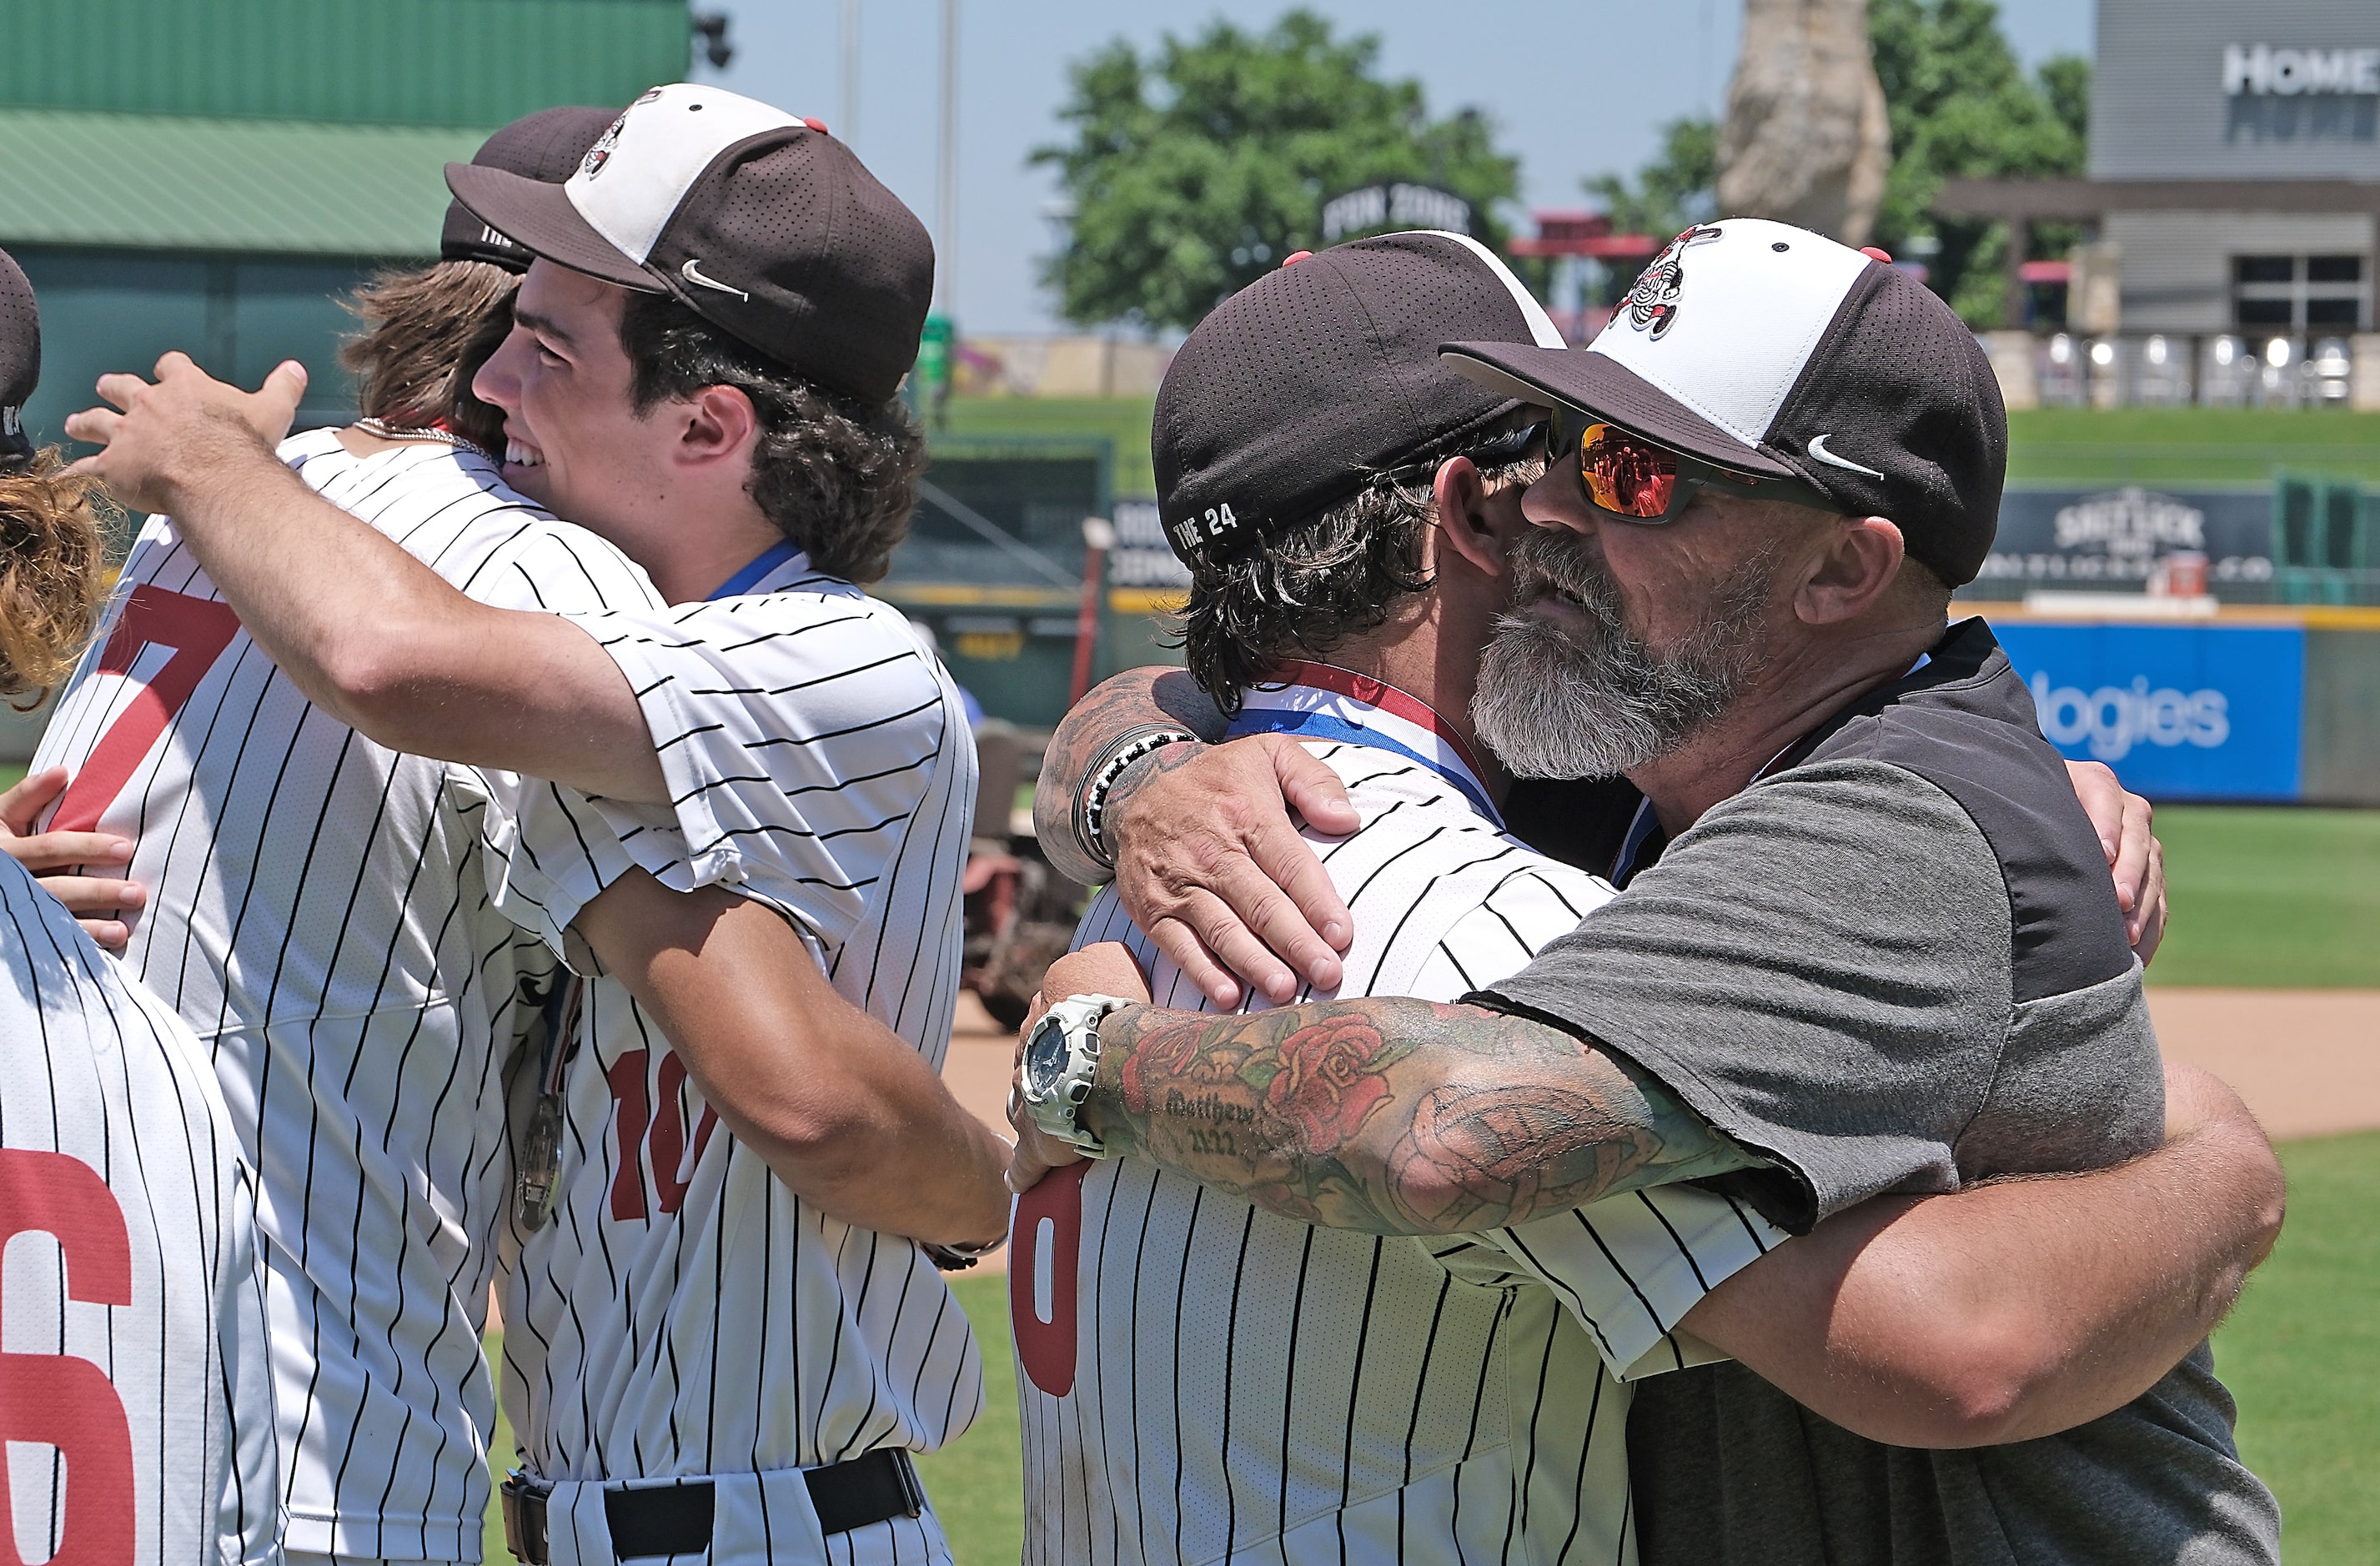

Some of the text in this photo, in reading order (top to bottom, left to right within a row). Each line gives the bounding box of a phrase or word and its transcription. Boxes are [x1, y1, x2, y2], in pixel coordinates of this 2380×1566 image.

[2222, 43, 2380, 95] HOME
[1172, 517, 1204, 550] THE
[1205, 503, 1238, 536] 24
[33, 583, 241, 874] 7
[2031, 670, 2230, 761] logies
[608, 1047, 719, 1222] 10
[1167, 1087, 1254, 1125] Matthew
[0, 1147, 137, 1566] 6
